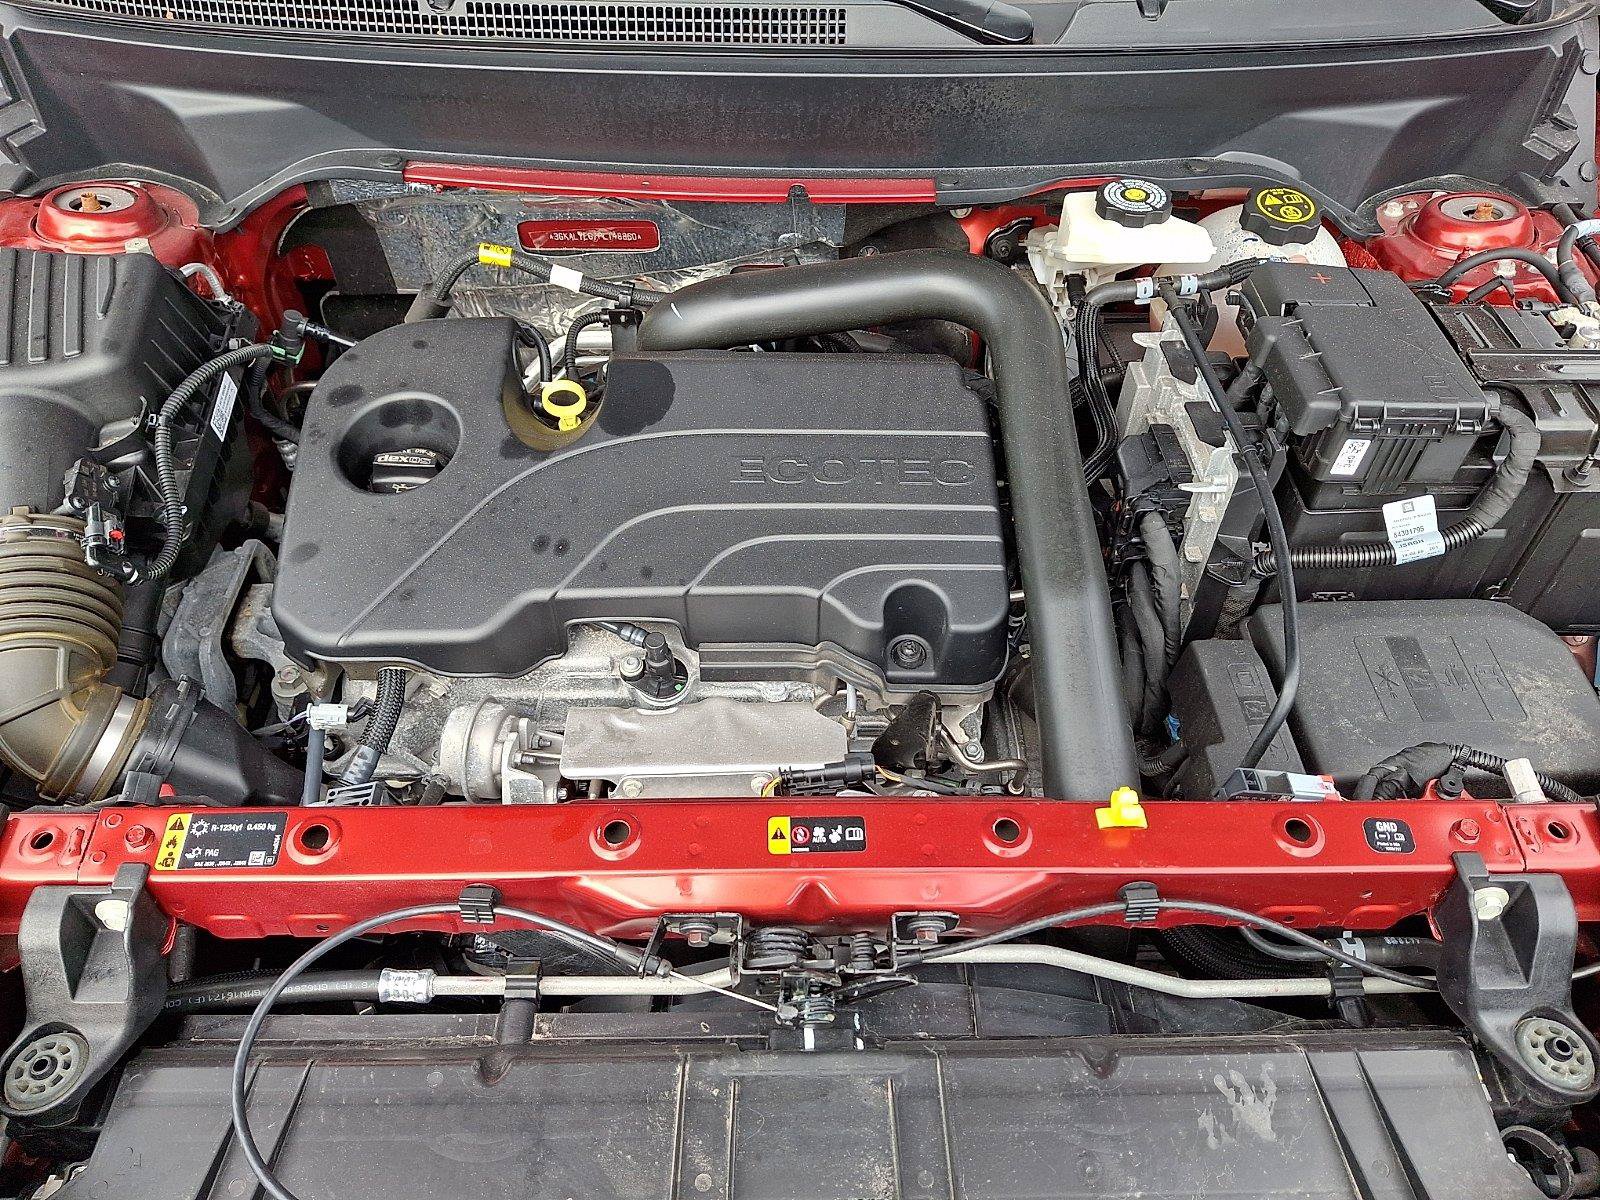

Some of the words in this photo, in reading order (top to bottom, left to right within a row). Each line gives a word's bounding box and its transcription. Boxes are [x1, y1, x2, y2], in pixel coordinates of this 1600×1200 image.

[730, 457, 978, 486] ECOTEC
[266, 822, 277, 832] kg
[1375, 821, 1398, 832] GND
[204, 848, 220, 857] PAG
